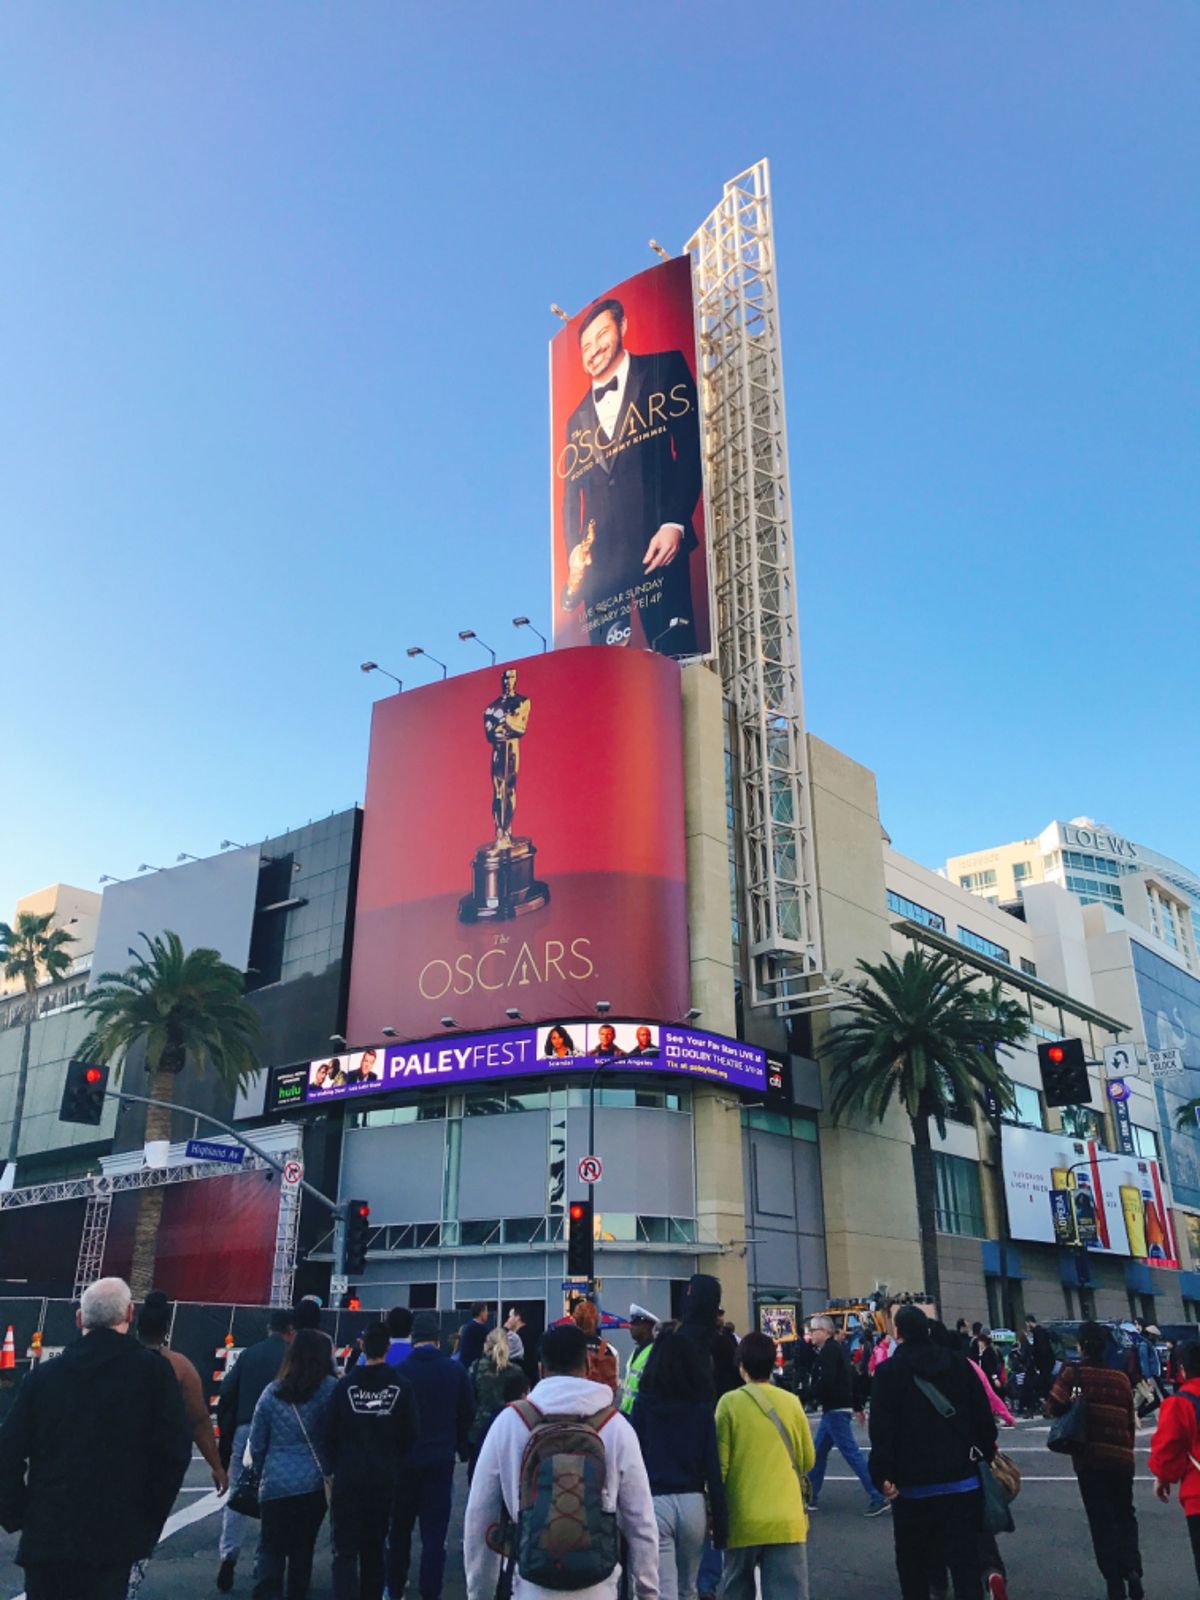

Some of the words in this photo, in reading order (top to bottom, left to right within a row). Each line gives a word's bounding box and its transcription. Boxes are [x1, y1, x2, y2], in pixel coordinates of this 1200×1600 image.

[557, 384, 690, 478] OSCARS
[605, 439, 631, 458] JIMMY
[633, 425, 667, 444] KIMMEL
[625, 576, 664, 600] SUNDAY
[606, 626, 632, 646] abc
[1063, 826, 1138, 859] LOEWS
[493, 934, 510, 945] The
[419, 938, 593, 1000] OSCARS
[665, 1033, 684, 1044] See
[686, 1036, 706, 1048] Your
[390, 1039, 532, 1079] PALEYFEST
[627, 1058, 653, 1067] Angeles
[666, 1060, 678, 1069] Tix
[682, 1048, 712, 1062] DOLBY
[713, 1053, 744, 1071] THEATRE
[1153, 1060, 1177, 1070] BLOCK
[278, 1086, 302, 1099] hulu
[191, 1143, 226, 1157] Highland
[229, 1149, 239, 1159] Av
[1055, 1194, 1068, 1226] OPERA
[359, 1389, 389, 1400] VANS
